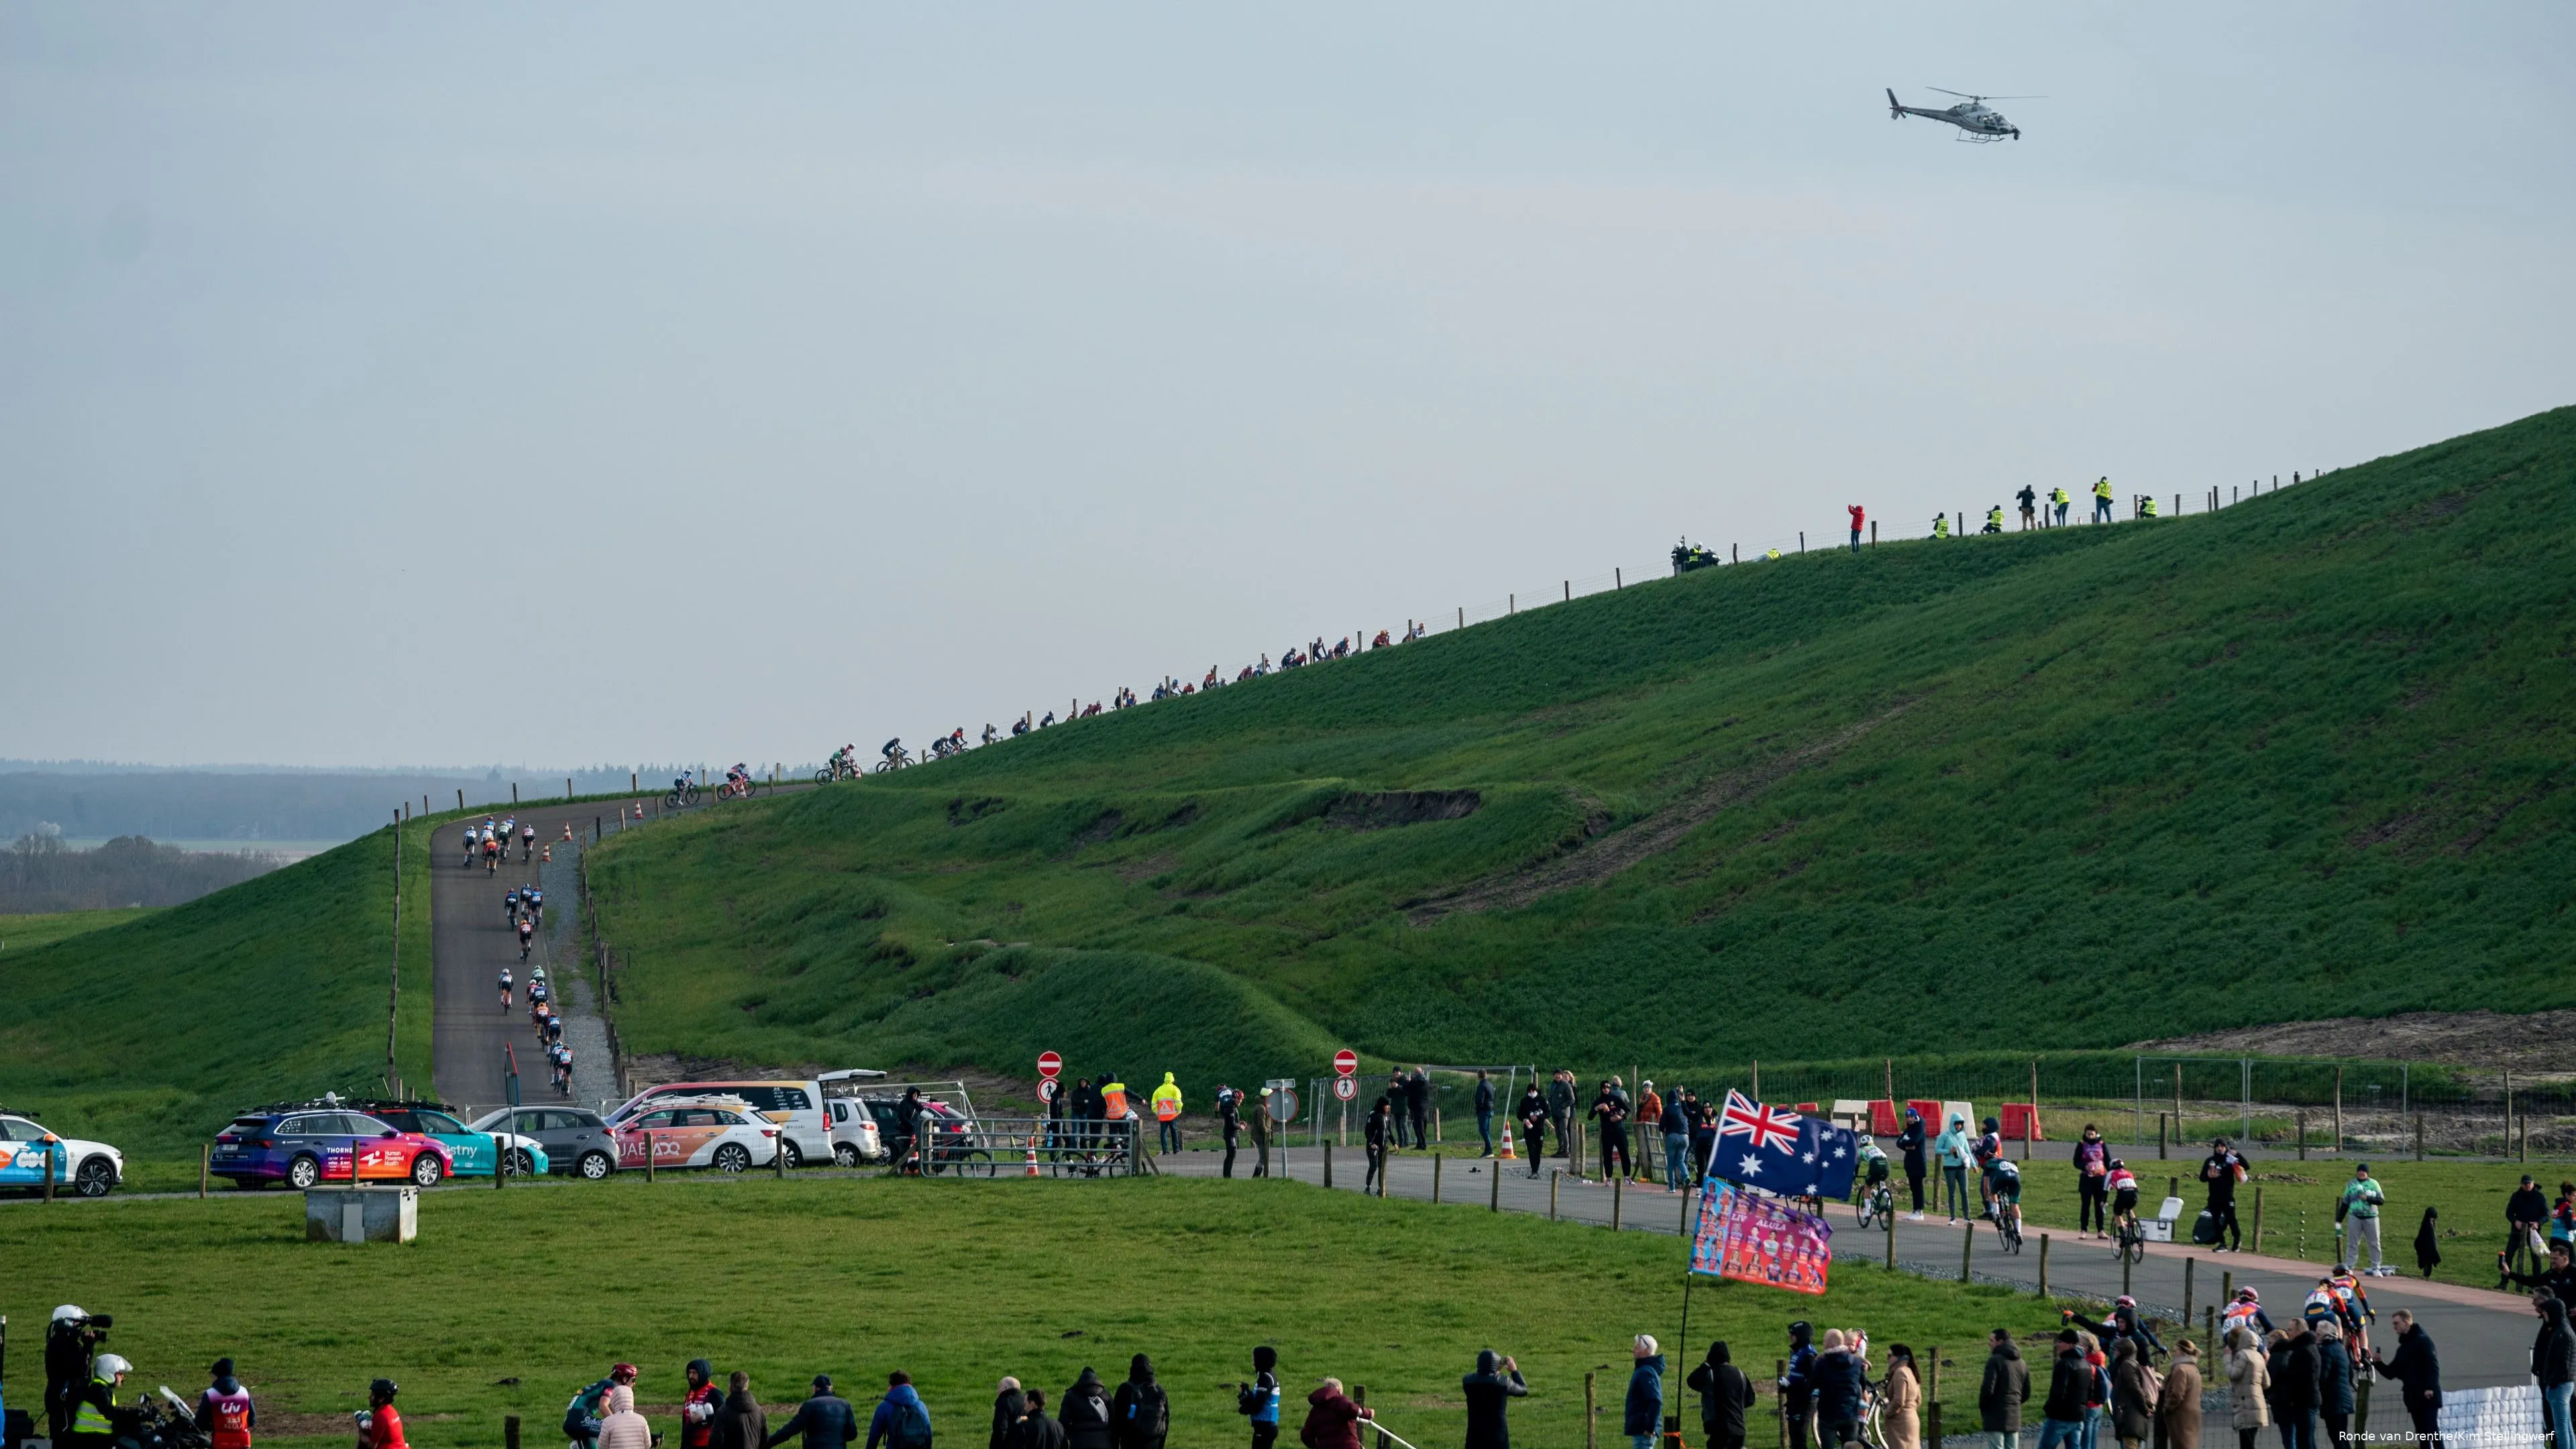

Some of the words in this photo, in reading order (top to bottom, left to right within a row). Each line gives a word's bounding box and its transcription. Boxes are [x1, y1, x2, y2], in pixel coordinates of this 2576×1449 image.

[1731, 1213, 1748, 1222] LIV
[1756, 1218, 1787, 1231] ALULA
[221, 1402, 241, 1413] Liv
